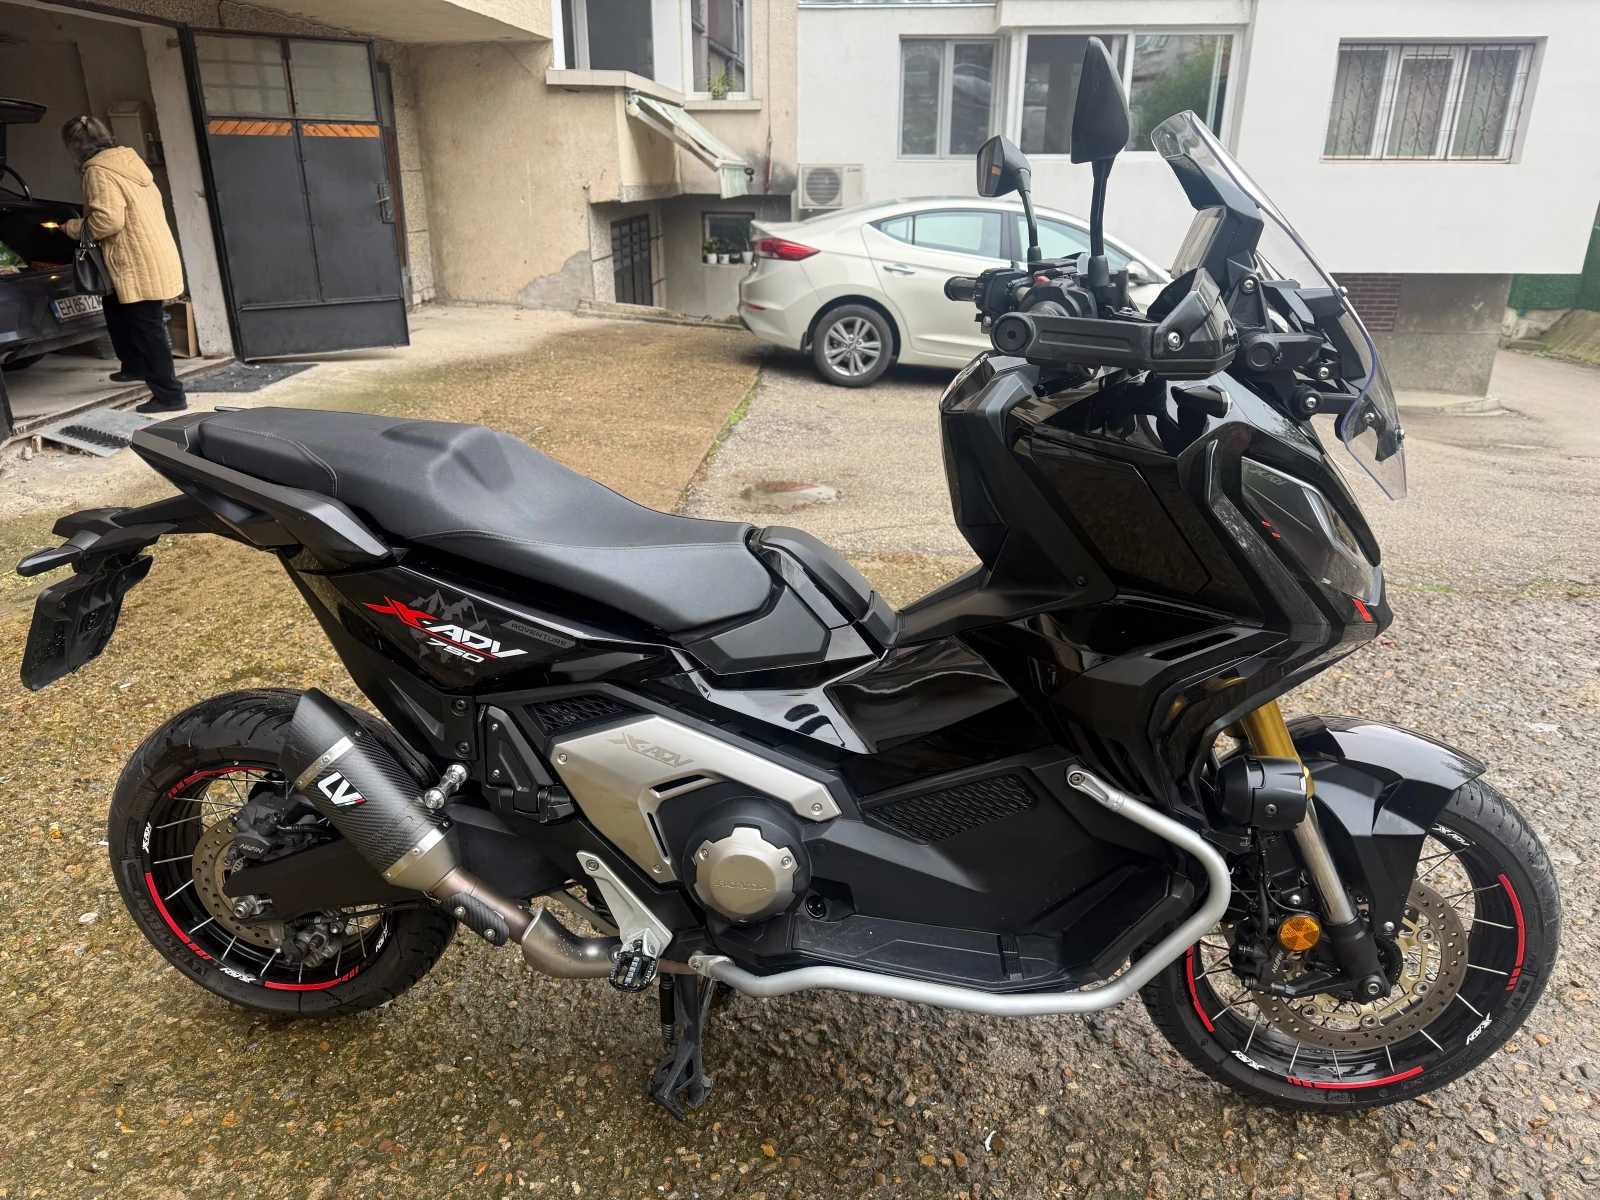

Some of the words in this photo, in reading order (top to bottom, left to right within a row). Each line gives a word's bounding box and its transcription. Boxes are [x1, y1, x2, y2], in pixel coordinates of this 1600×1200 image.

[361, 596, 529, 659] X-ADV
[511, 623, 568, 647] ADVENTURE
[426, 637, 485, 663] 750
[606, 732, 695, 768] X-ADV
[317, 771, 365, 806] LV
